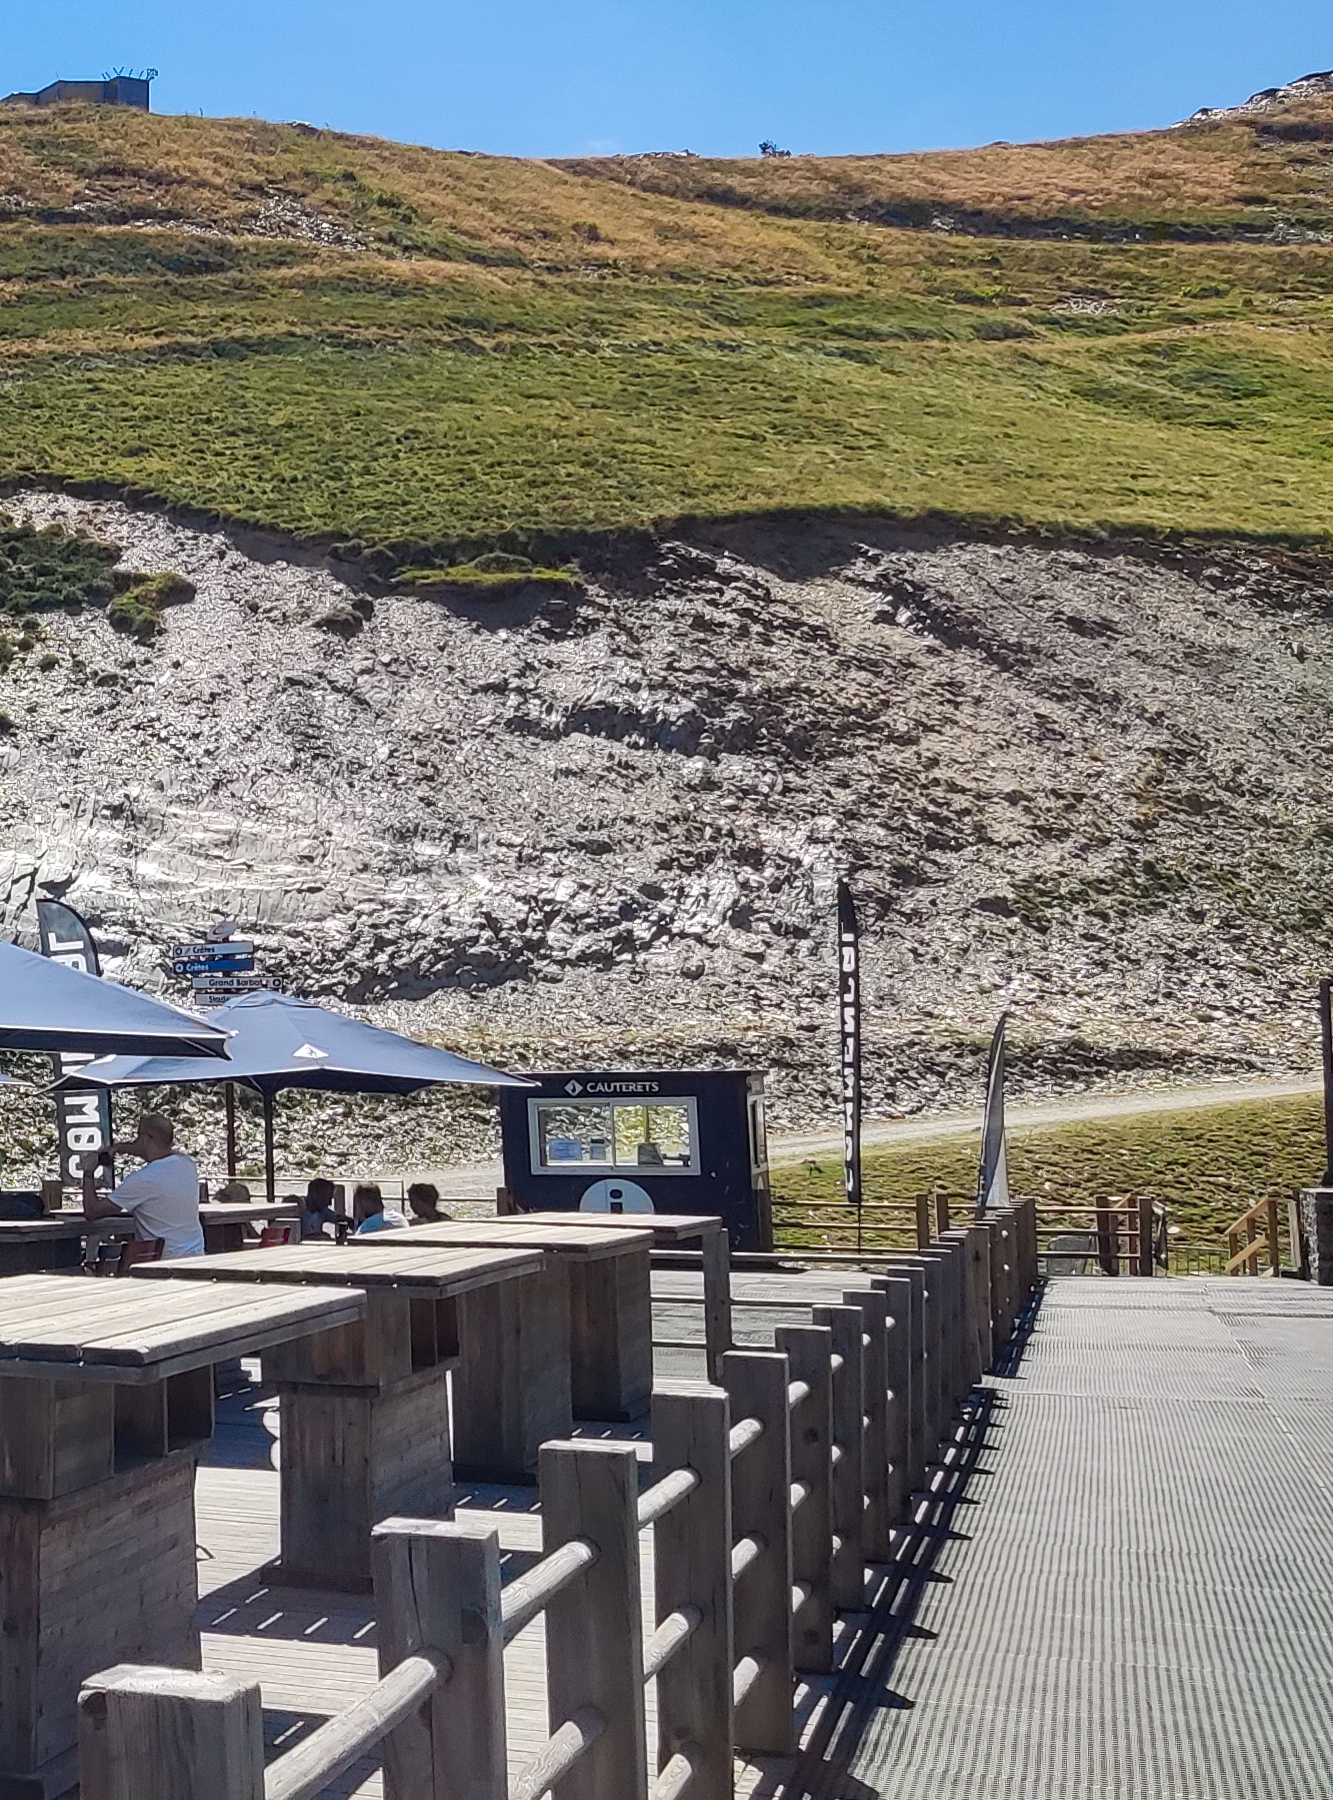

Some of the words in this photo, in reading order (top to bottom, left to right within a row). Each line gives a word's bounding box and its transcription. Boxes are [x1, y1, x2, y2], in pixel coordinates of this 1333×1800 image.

[185, 962, 209, 971] Crêtes
[208, 979, 234, 987] Grand
[586, 1081, 660, 1093] CAUTERETS
